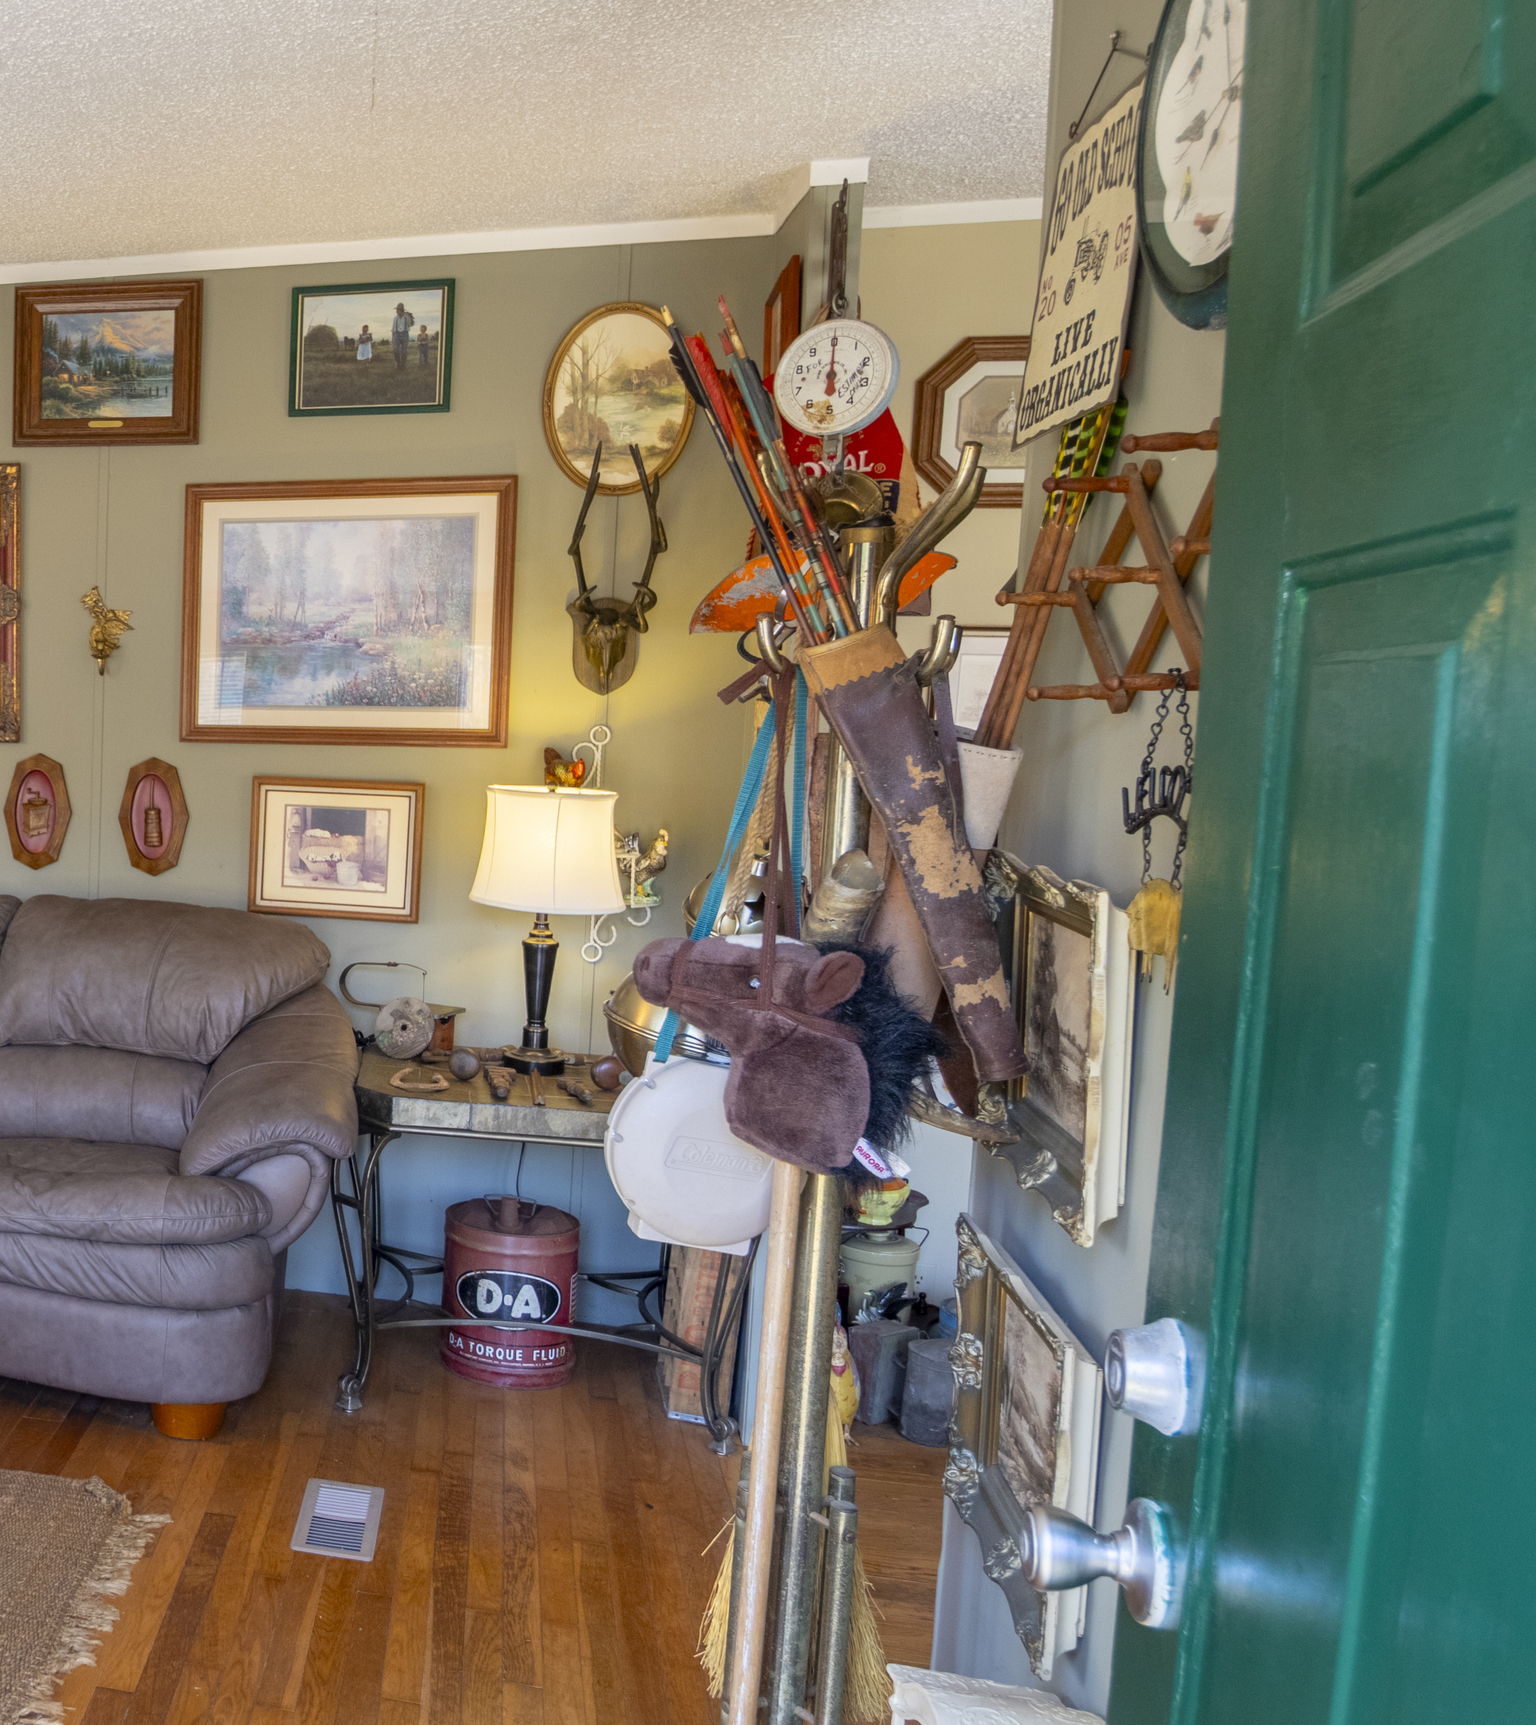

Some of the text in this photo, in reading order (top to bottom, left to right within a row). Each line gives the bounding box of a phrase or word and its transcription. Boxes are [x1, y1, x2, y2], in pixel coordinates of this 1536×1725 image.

[1072, 138, 1099, 222] OLD
[1115, 214, 1133, 252] 05
[1113, 250, 1129, 271] AVE
[1041, 274, 1055, 296] NO
[1037, 293, 1057, 322] 20
[830, 337, 839, 347] 0
[1050, 308, 1097, 368] LIVE
[809, 347, 817, 358] 9
[862, 356, 870, 367] 2
[795, 364, 803, 375] 8
[795, 386, 803, 396] 7
[860, 377, 869, 388] 3
[1018, 335, 1120, 432] ORGANICALLY
[805, 399, 814, 409] 6
[826, 405, 834, 415] 5
[846, 396, 854, 405] 4
[682, 1142, 749, 1171] Coleman
[855, 1145, 885, 1173] AURORA
[468, 1341, 523, 1361] TORQUE
[533, 1346, 566, 1361] FLUID
